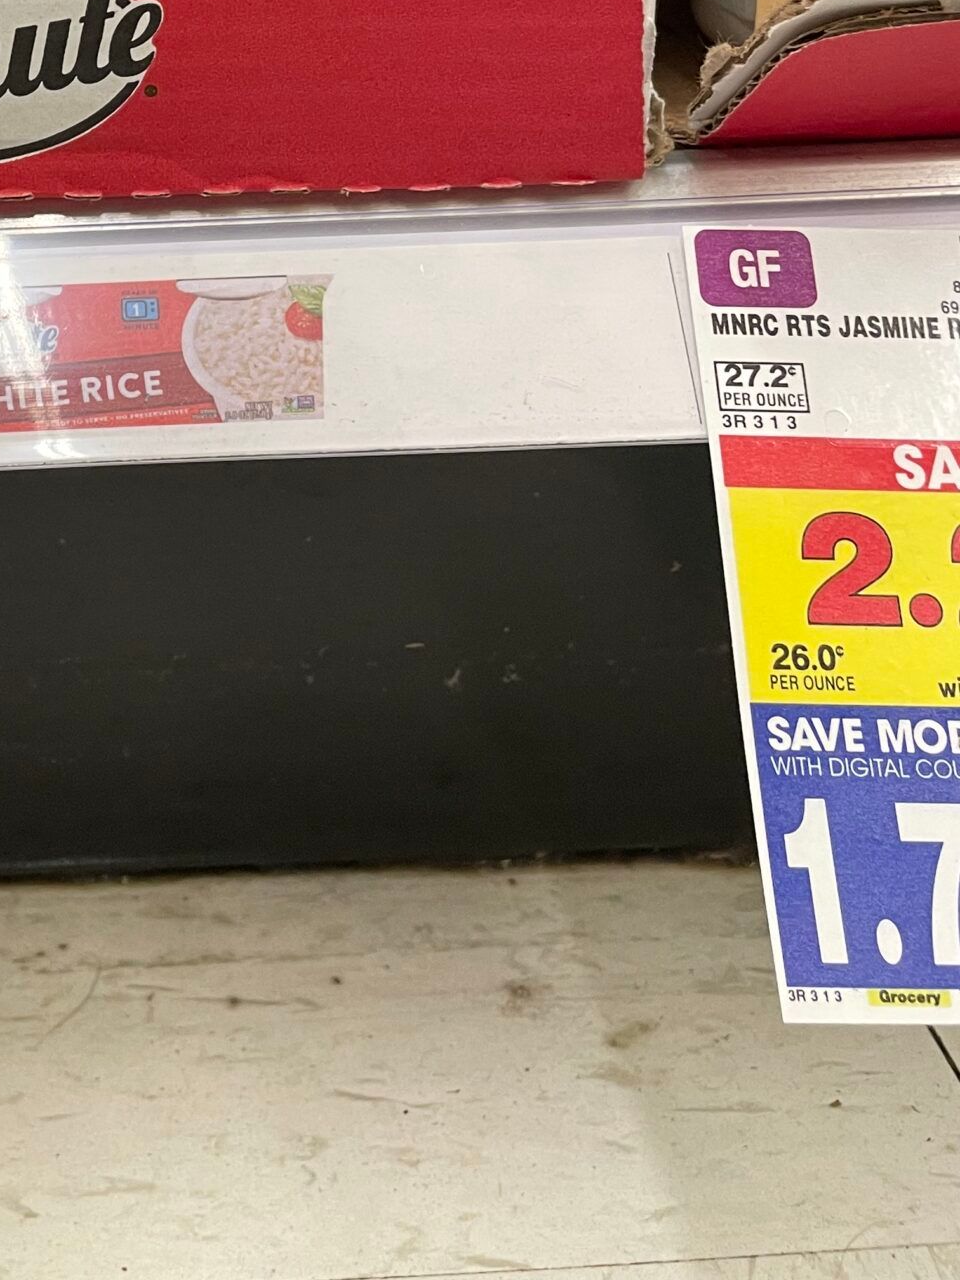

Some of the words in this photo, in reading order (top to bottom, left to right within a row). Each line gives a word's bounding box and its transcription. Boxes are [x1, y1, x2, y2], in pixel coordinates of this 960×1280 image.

[728, 248, 781, 288] GF
[941, 300, 959, 314] 69
[711, 313, 779, 336] MNRC
[786, 313, 832, 337] RTS
[839, 315, 942, 340] JASMINE
[79, 369, 165, 404] RICE
[723, 392, 752, 407] PER
[757, 392, 806, 408] OUNCE
[770, 674, 799, 690] PER
[803, 675, 856, 692] OUNCE
[767, 715, 866, 753] SAVE
[770, 756, 823, 777] WITH
[829, 757, 911, 779] DIGITAL
[879, 989, 941, 1007] Grocery
